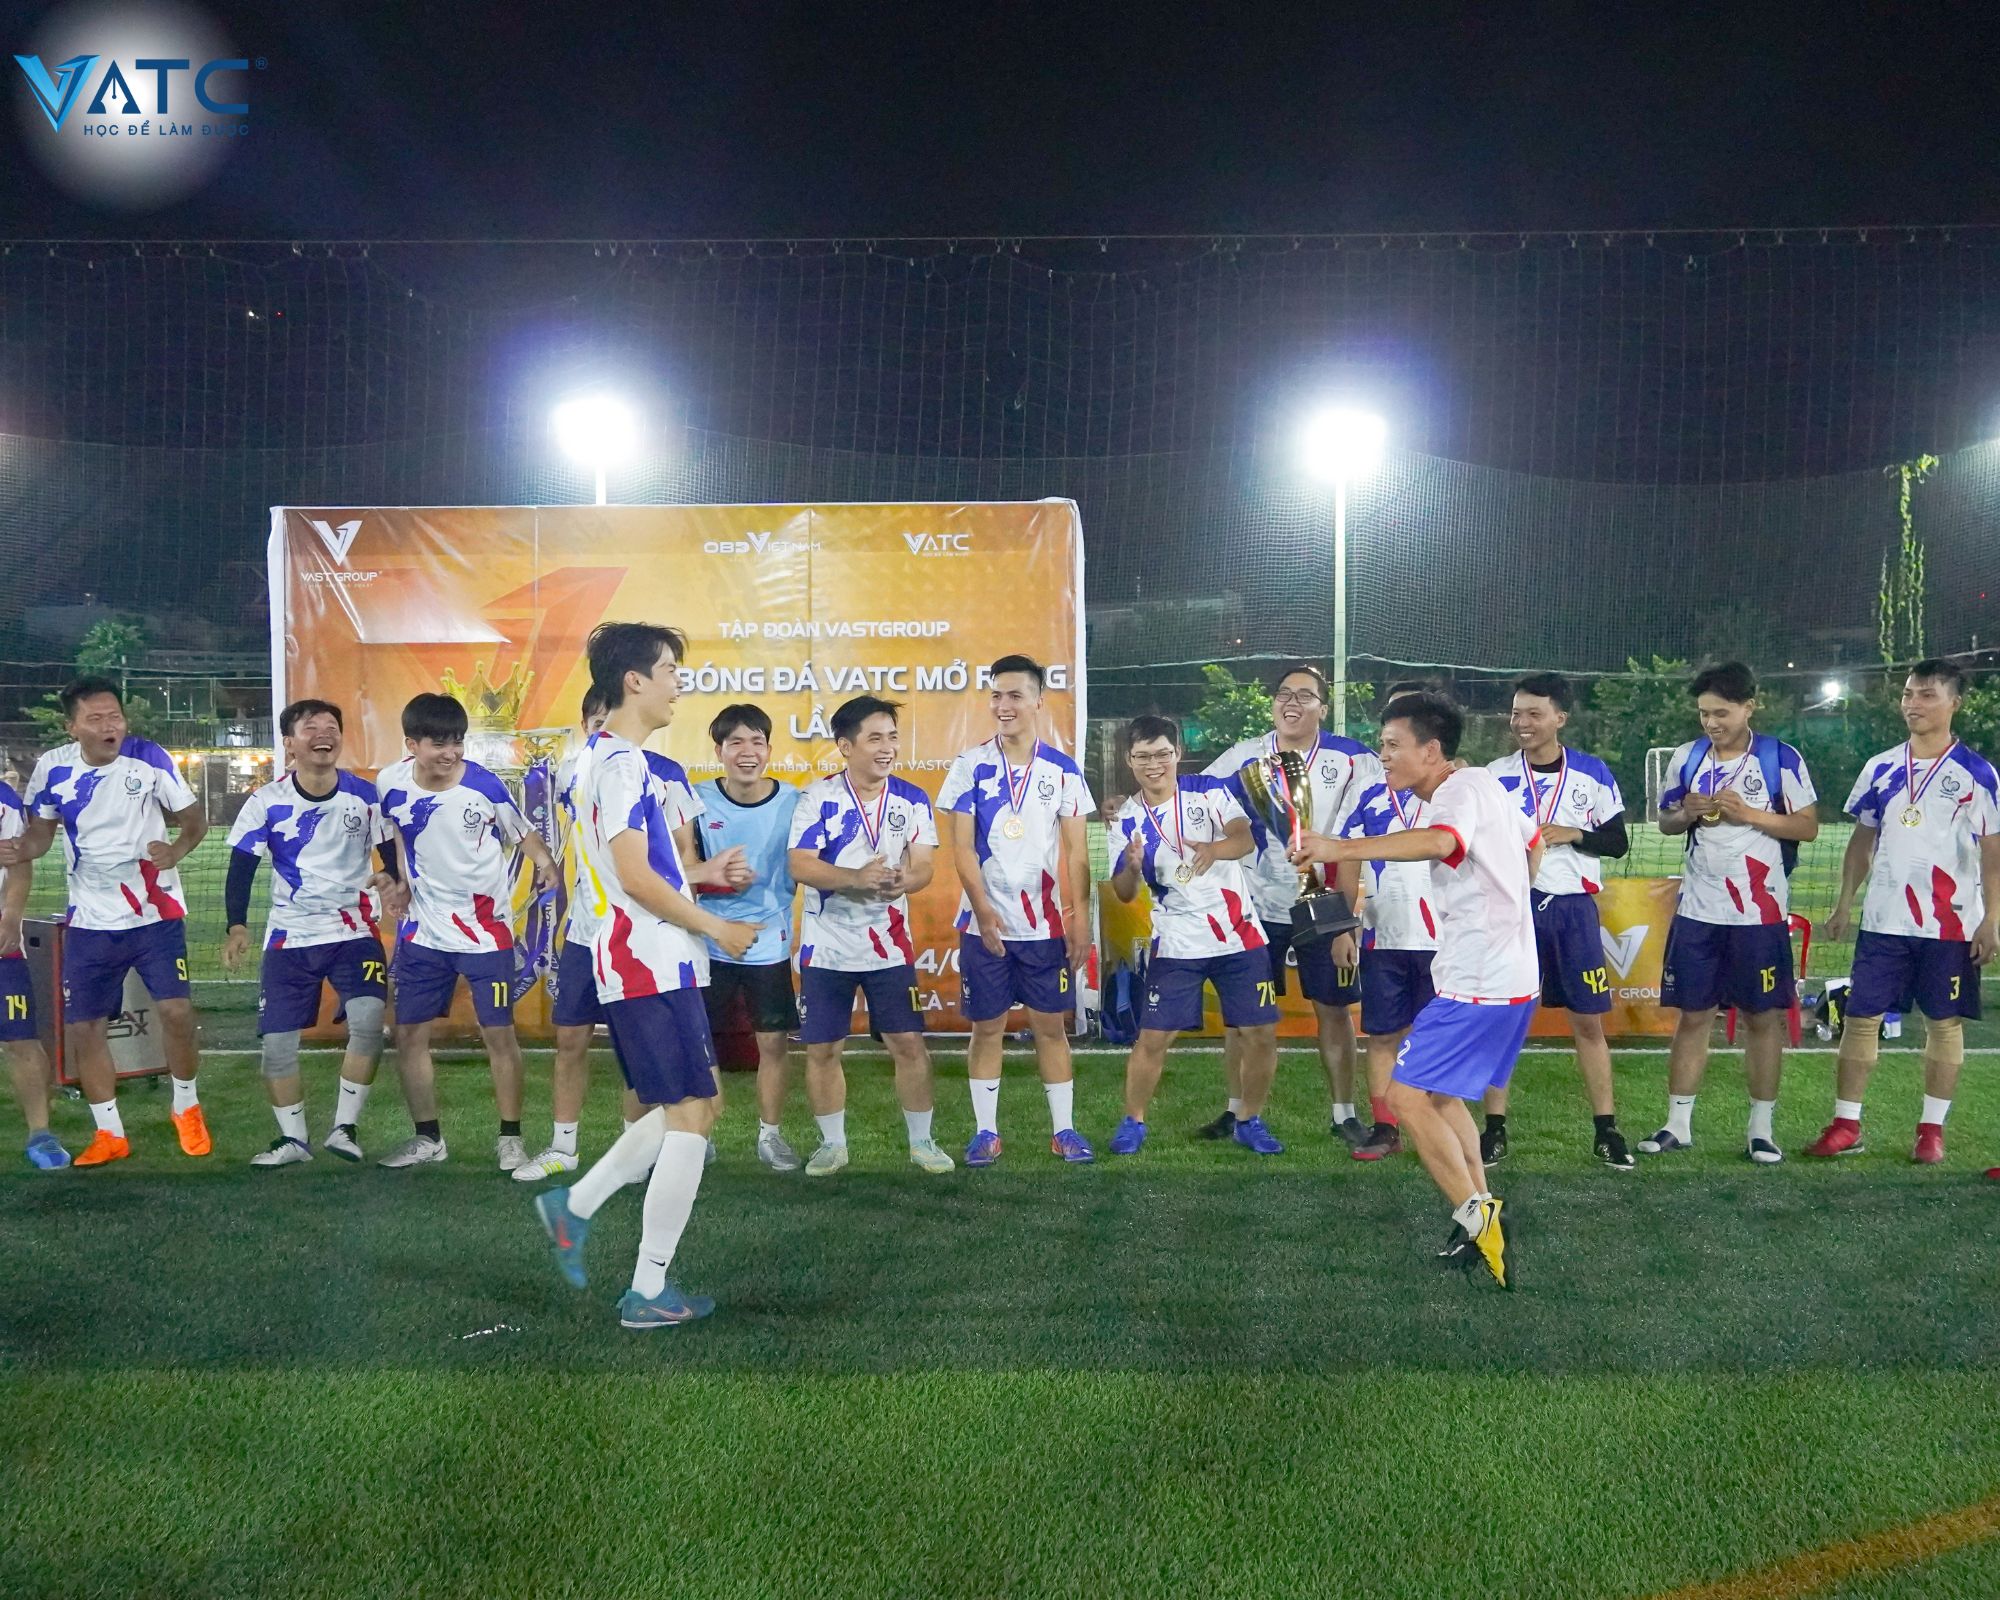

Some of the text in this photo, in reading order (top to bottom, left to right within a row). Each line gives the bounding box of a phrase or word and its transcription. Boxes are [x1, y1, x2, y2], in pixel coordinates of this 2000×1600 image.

[903, 533, 969, 555] VATC
[300, 571, 378, 582] VAST GROUP
[718, 618, 951, 643] TẬP ĐOÀN VASTGROUP
[772, 661, 820, 692] ĐÁ
[823, 666, 907, 692] VATC
[916, 658, 968, 692] MỞ
[176, 958, 188, 981] 9
[362, 961, 386, 984] 72
[1059, 967, 1068, 993] 6
[1582, 967, 1609, 994] 42
[1760, 965, 1776, 993] 15
[491, 982, 508, 1007] 11
[1618, 987, 1661, 999] GROU
[1950, 975, 1960, 1000] 3
[5, 995, 28, 1020] 14
[1396, 1039, 1411, 1067] 2
